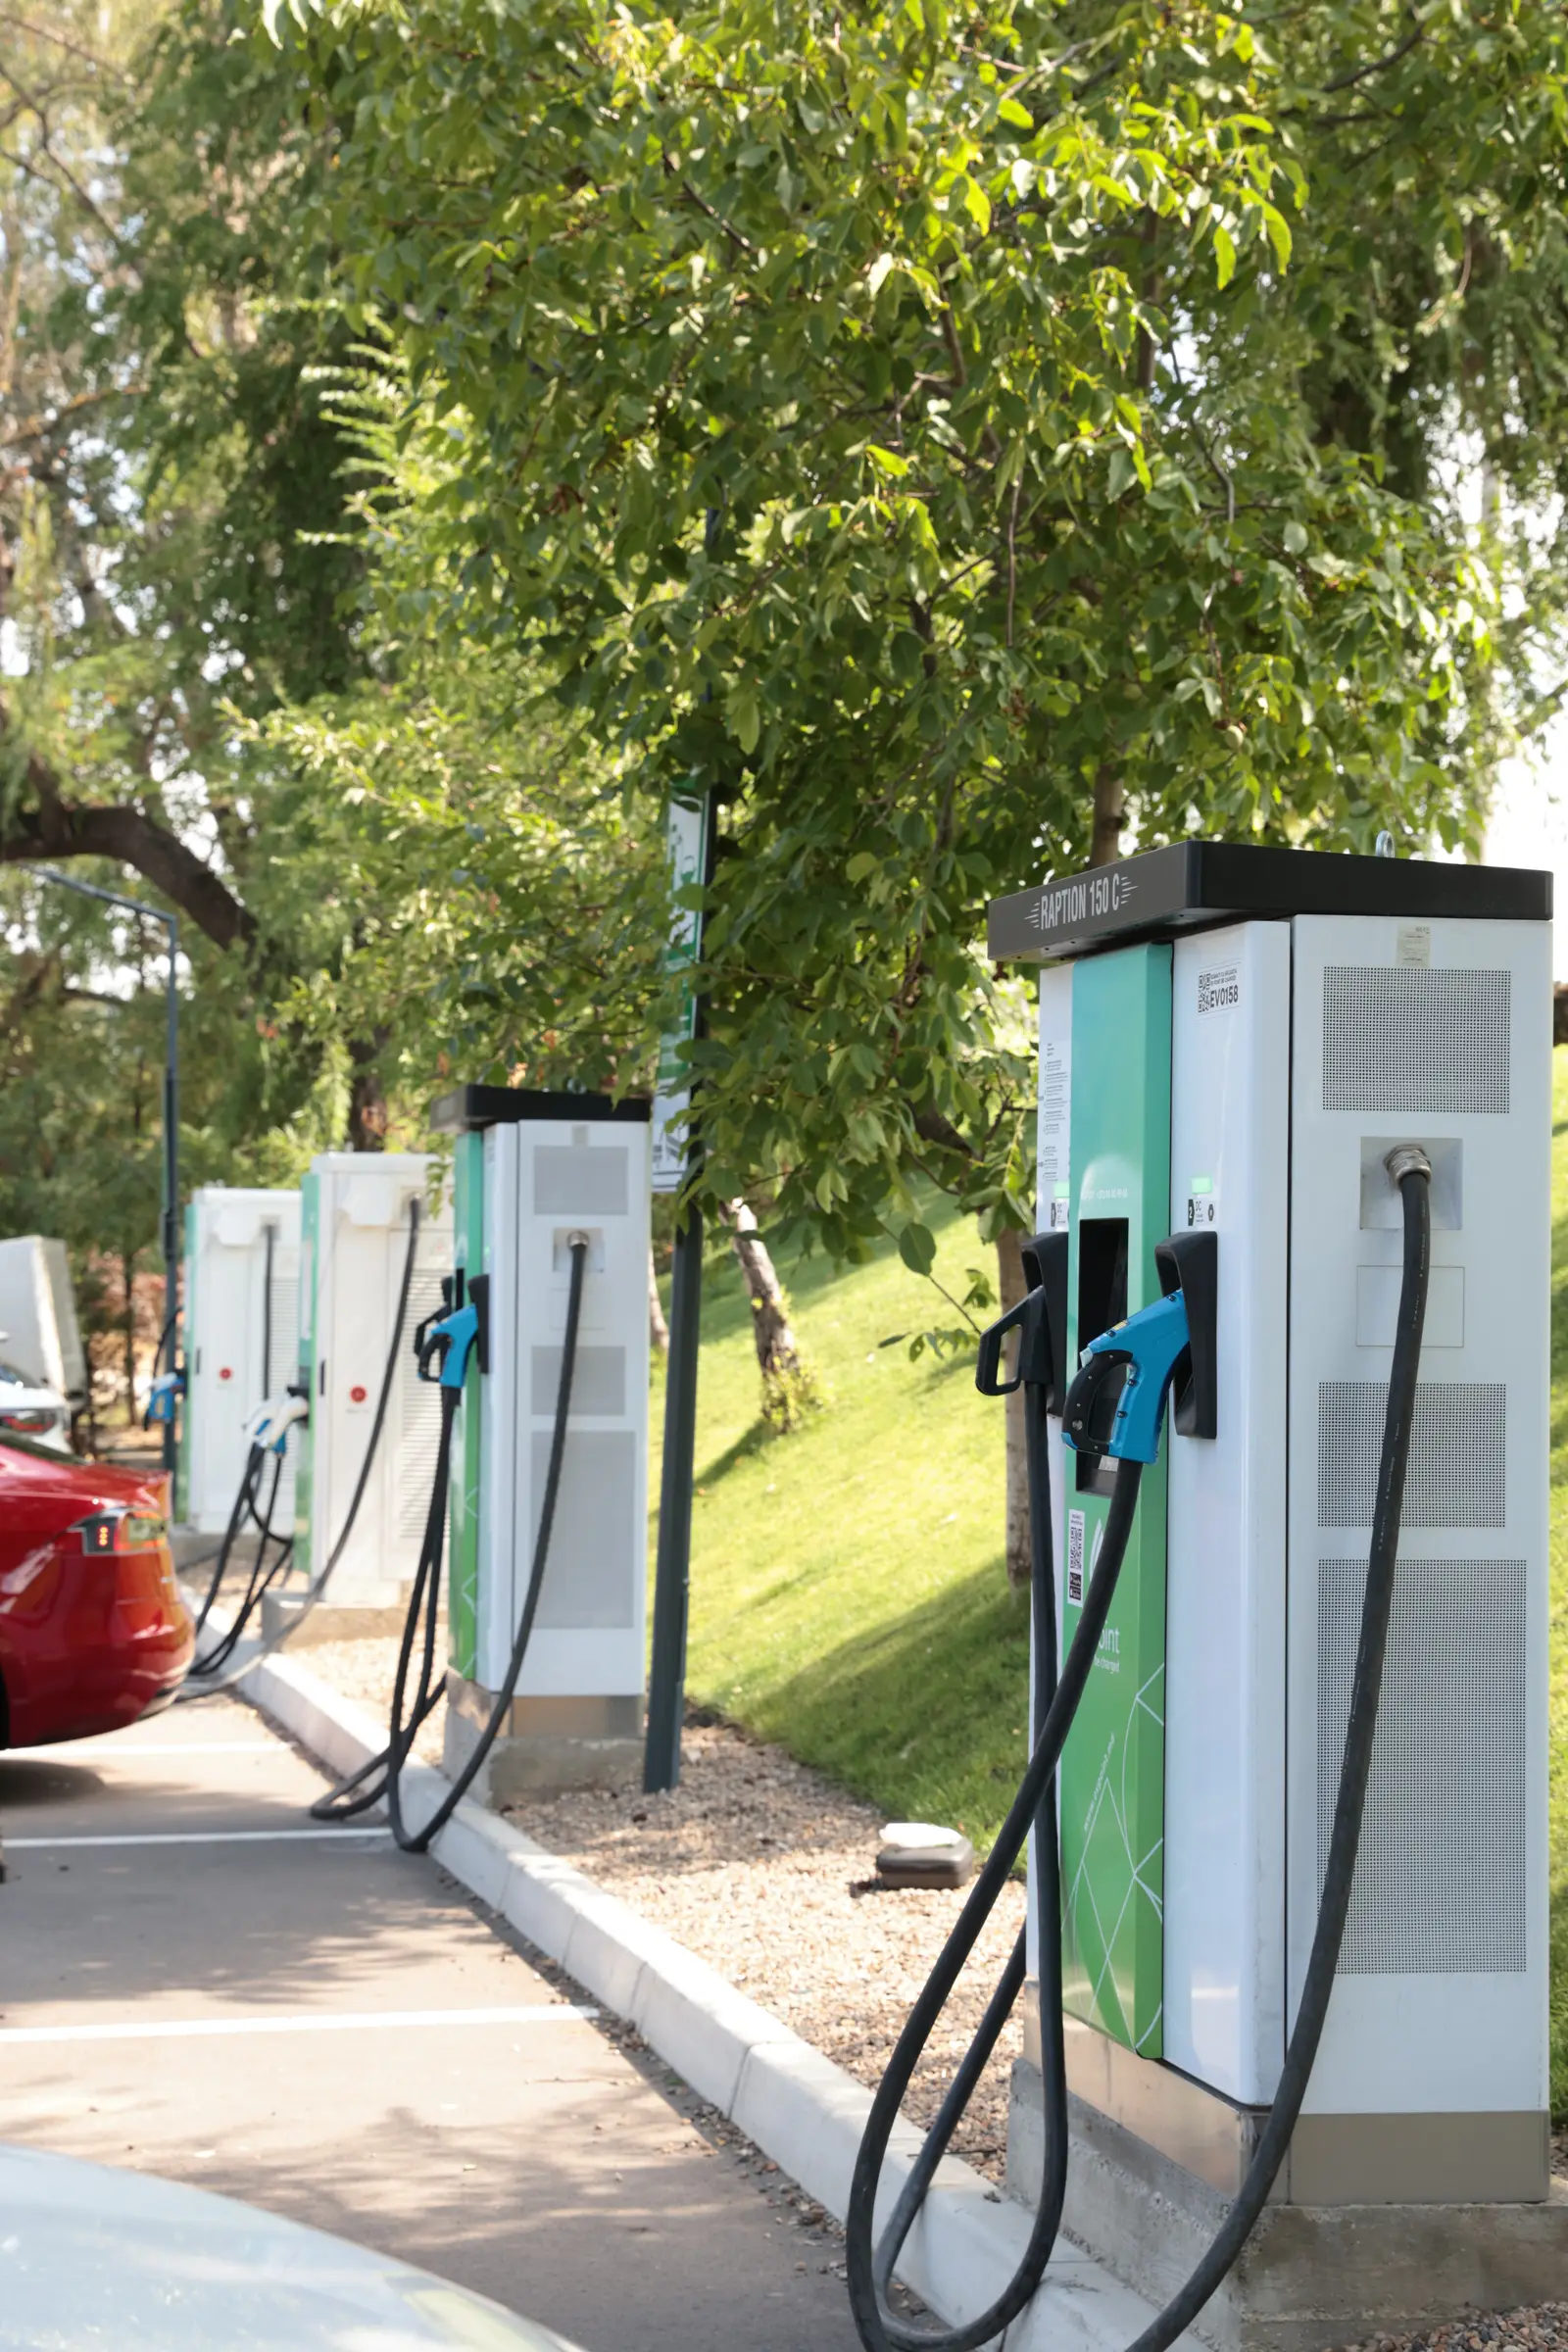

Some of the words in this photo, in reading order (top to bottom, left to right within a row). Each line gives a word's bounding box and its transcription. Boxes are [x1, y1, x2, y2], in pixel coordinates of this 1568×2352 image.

[1041, 883, 1087, 930] RAPTION
[1089, 876, 1109, 916] 150
[1111, 872, 1120, 911] C
[1209, 984, 1239, 1008] EV0158
[1195, 1200, 1202, 1211] DC
[1098, 1621, 1120, 1654] oint
